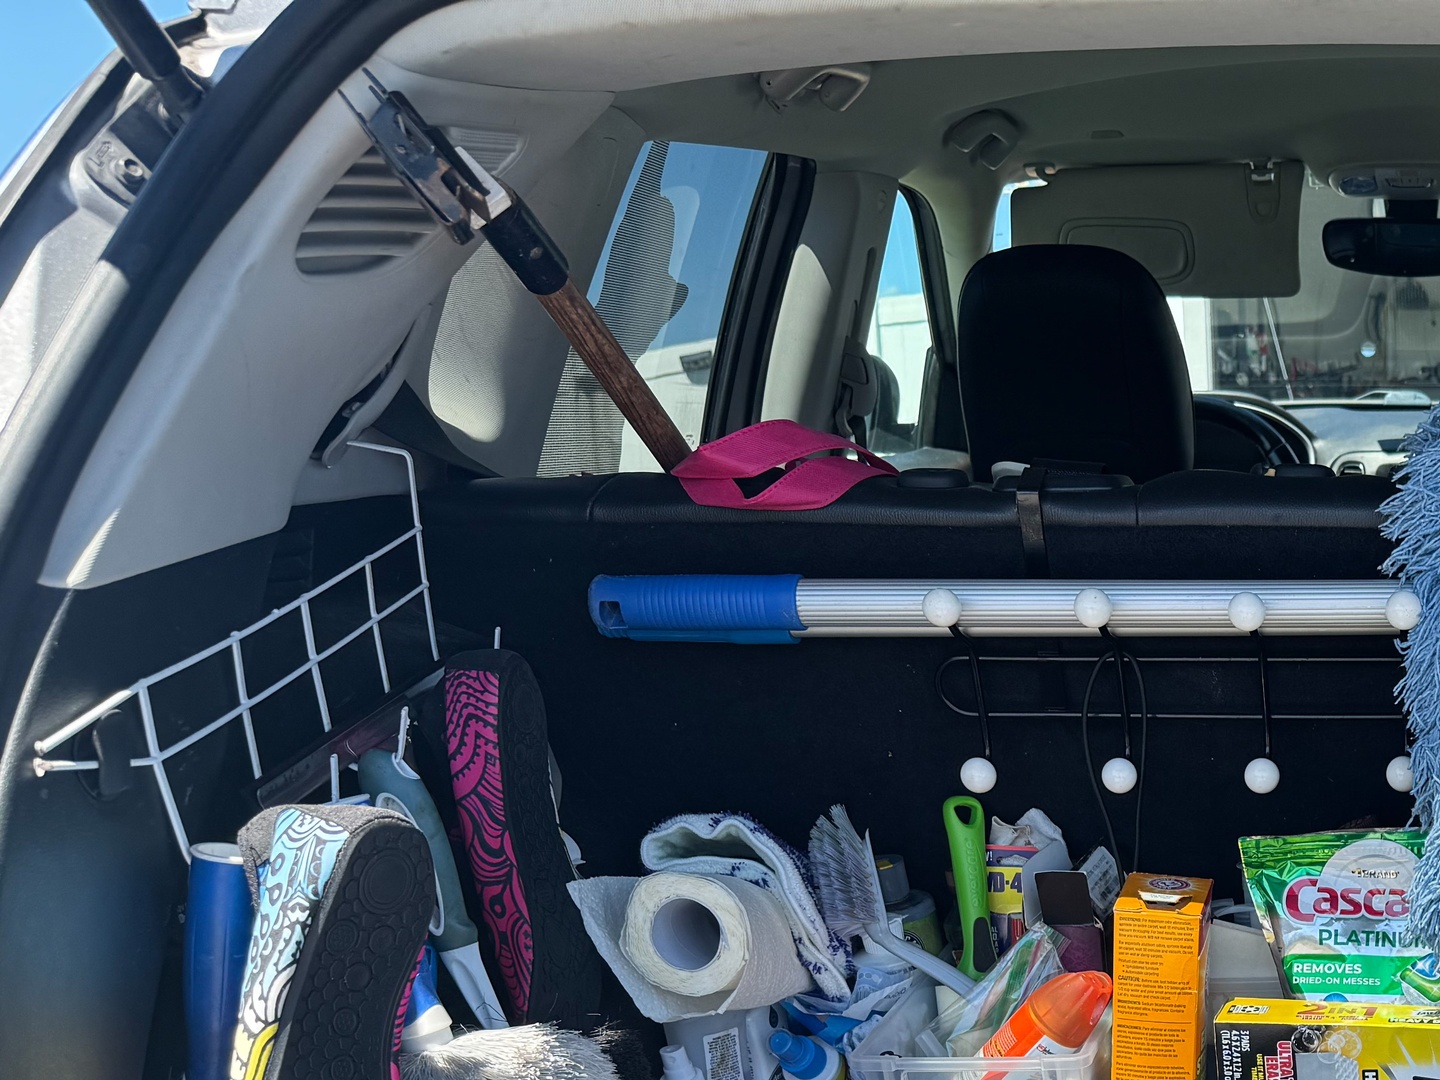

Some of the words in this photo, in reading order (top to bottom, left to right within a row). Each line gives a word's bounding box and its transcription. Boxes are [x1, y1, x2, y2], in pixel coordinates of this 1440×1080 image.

[1292, 963, 1363, 975] REMOVES
[1292, 976, 1340, 985] DRIED-ON
[1342, 977, 1381, 986] MESSES
[1231, 1030, 1240, 1041] 4.6
[1241, 1036, 1250, 1052] PADS
[1222, 1050, 1231, 1060] 6.0
[1232, 1047, 1241, 1057] 2.4
[1277, 1040, 1293, 1076] ULTRA
[1224, 1066, 1232, 1076] 3.0
[1234, 1063, 1242, 1072] 1.2
[1234, 1072, 1242, 1080] in.
